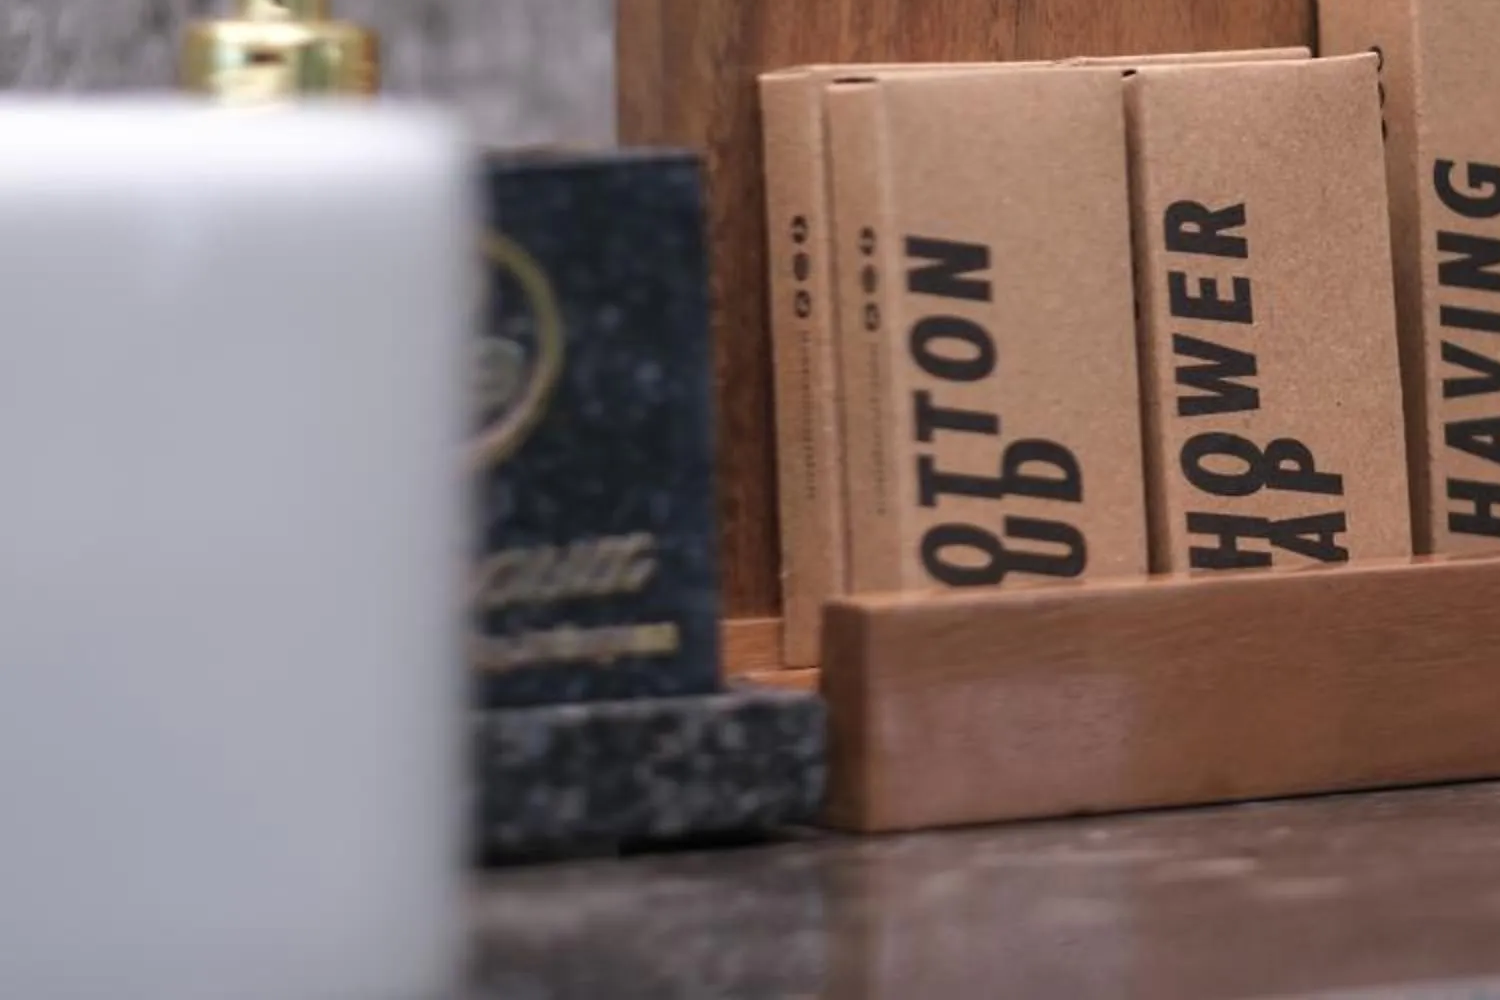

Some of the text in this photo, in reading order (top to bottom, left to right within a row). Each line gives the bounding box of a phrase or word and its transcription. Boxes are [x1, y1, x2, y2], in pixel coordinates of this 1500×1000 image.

[904, 234, 1004, 587] OTTON
[1002, 437, 1088, 579] UD
[1163, 199, 1273, 571] HOWER
[1267, 436, 1350, 564] AP
